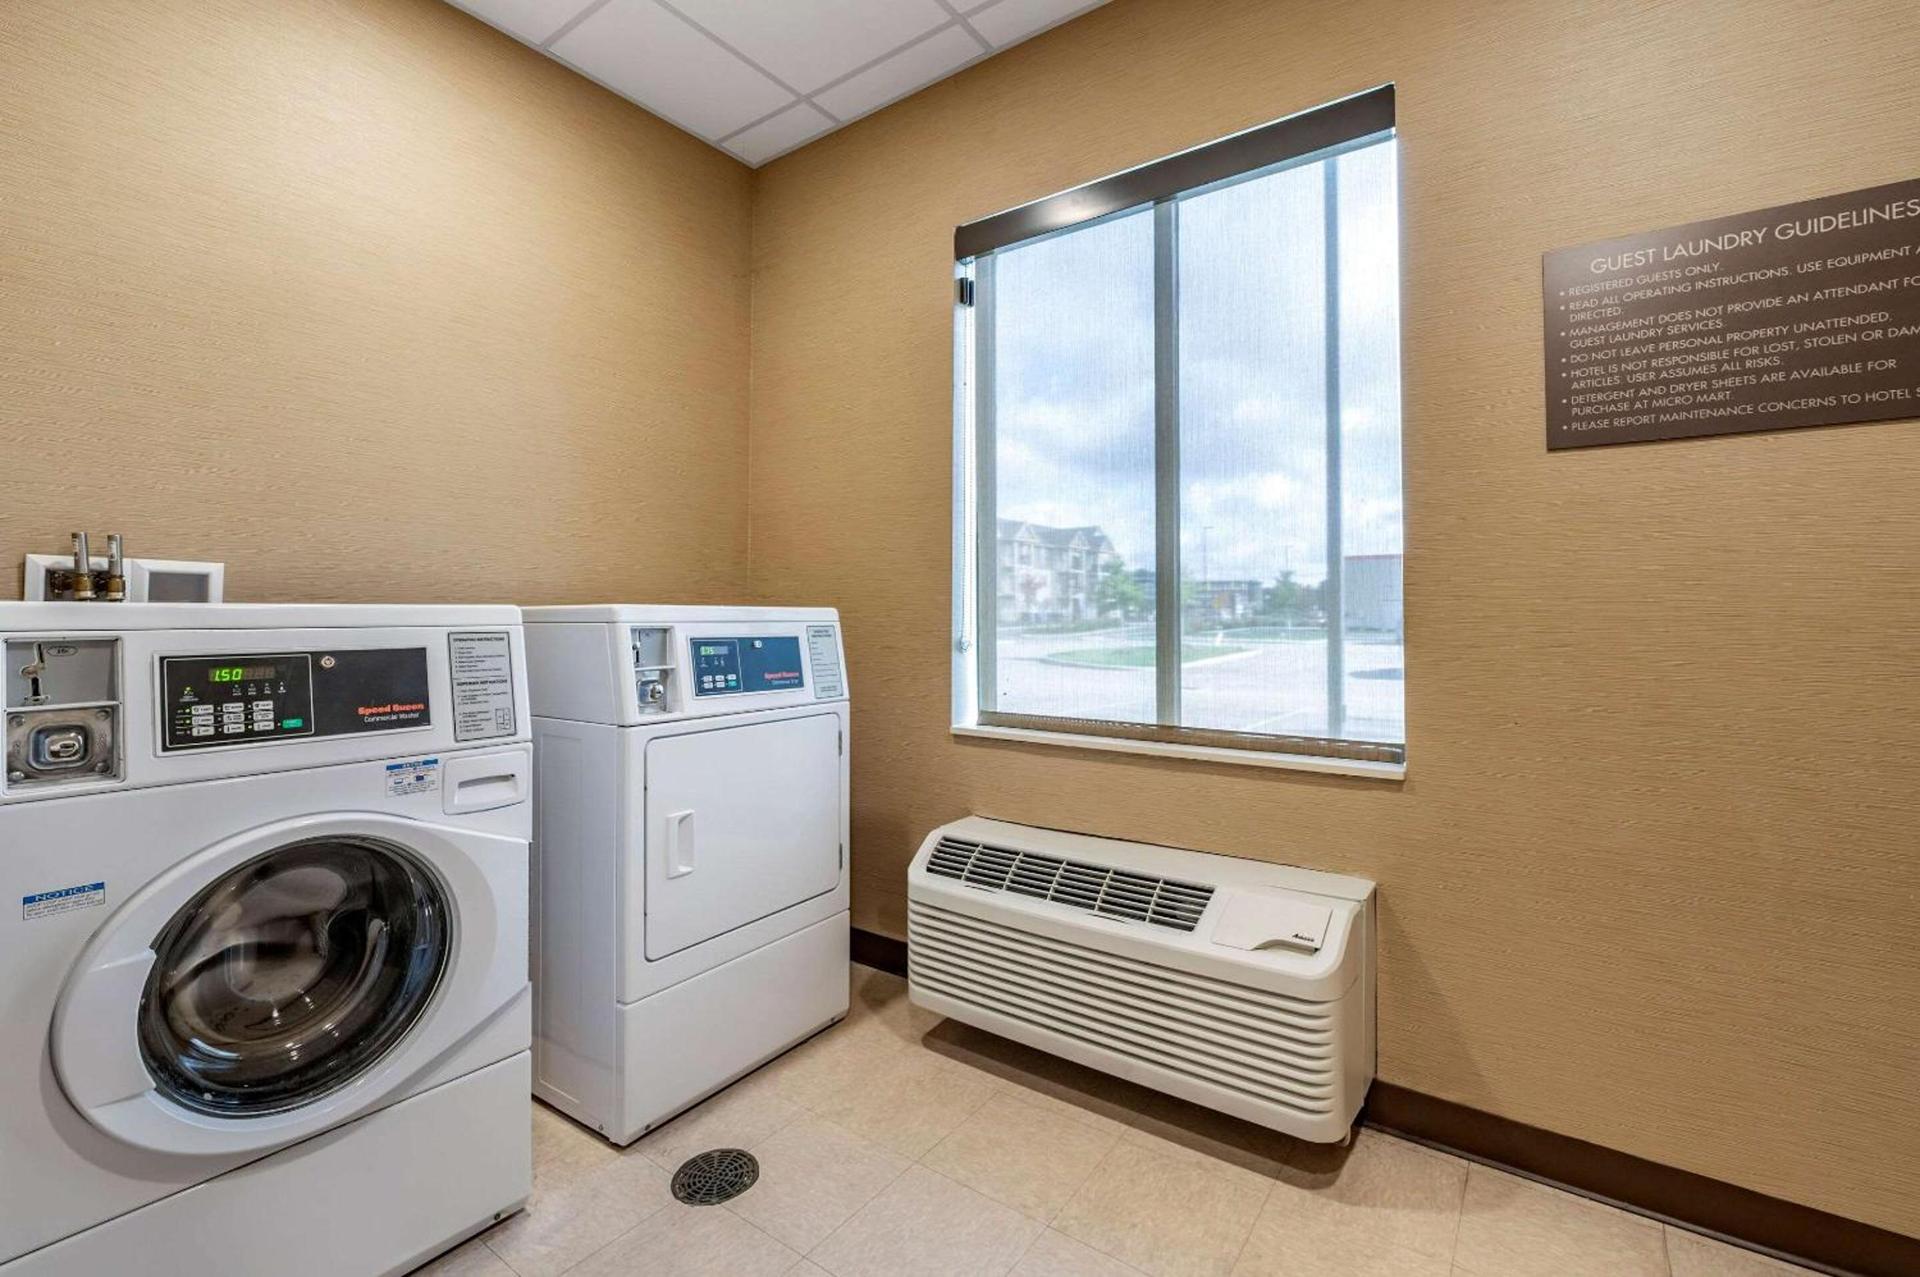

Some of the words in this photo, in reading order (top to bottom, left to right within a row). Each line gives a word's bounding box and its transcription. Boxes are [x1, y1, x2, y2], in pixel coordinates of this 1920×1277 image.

[1590, 249, 1656, 274] GUEST
[1664, 228, 1768, 261] LAUNDRY
[1775, 199, 1920, 240] GUIDELINES
[1568, 278, 1632, 296] REGISTERED
[1636, 270, 1681, 284] GUESTS
[1685, 262, 1724, 276] ONLY.
[1570, 298, 1598, 311] READ
[1602, 296, 1619, 304] ALL
[1623, 283, 1692, 302] OPERATING
[1696, 267, 1792, 290] INSTRUCTIONS.
[1797, 260, 1822, 273] USE
[1827, 246, 1912, 268] EQUIPMENT
[1570, 316, 1654, 338] MANAGEMENT
[1659, 311, 1692, 323] DOES
[1696, 305, 1723, 318] NOT
[1728, 296, 1783, 314] PROVIDE
[1787, 292, 1808, 305] AN
[1813, 278, 1900, 301] ATTENDANT
[1570, 308, 1624, 322] DIRECTED.
[1570, 336, 1604, 349] GUEST
[1610, 328, 1662, 344] LAUNDRY
[1571, 354, 1588, 364] DO
[1592, 351, 1616, 361] NOT
[1621, 344, 1655, 357] LEAVE
[1659, 335, 1723, 350] PERSONAL
[1727, 325, 1789, 342] PROPERTY
[1794, 312, 1892, 334] UNATTENDED.
[1571, 366, 1605, 378] HOTEL
[1609, 364, 1618, 373] IS
[1622, 361, 1648, 371] NOT
[1652, 350, 1729, 367] RESPONSIBLE
[1734, 346, 1759, 357] FOR
[1764, 341, 1800, 354] LOST,
[1804, 334, 1857, 349] STOLEN
[1861, 330, 1883, 340] OR
[1572, 390, 1634, 405] DETERGENT
[1638, 386, 1666, 397] AND
[1670, 380, 1707, 394] DRYER
[1712, 375, 1757, 389] SHEETS
[1761, 372, 1786, 384] ARE
[1790, 362, 1862, 380] AVAILABLE
[1868, 359, 1897, 371] FOR
[1627, 372, 1656, 383] USER
[1659, 364, 1717, 379] ASSUMES
[1721, 362, 1741, 372] ALL
[1746, 356, 1783, 369] RISKS.
[1572, 401, 1630, 416] PURCHASE
[1634, 400, 1648, 410] AT
[1652, 395, 1693, 408] MICRO
[1572, 419, 1609, 432] PLEASE
[1613, 414, 1656, 428] REPORT
[1659, 404, 1754, 423] MAINTENANCE
[1758, 396, 1837, 413] CONCERNS
[1841, 394, 1861, 404] TO
[1865, 388, 1911, 402] HOTEL
